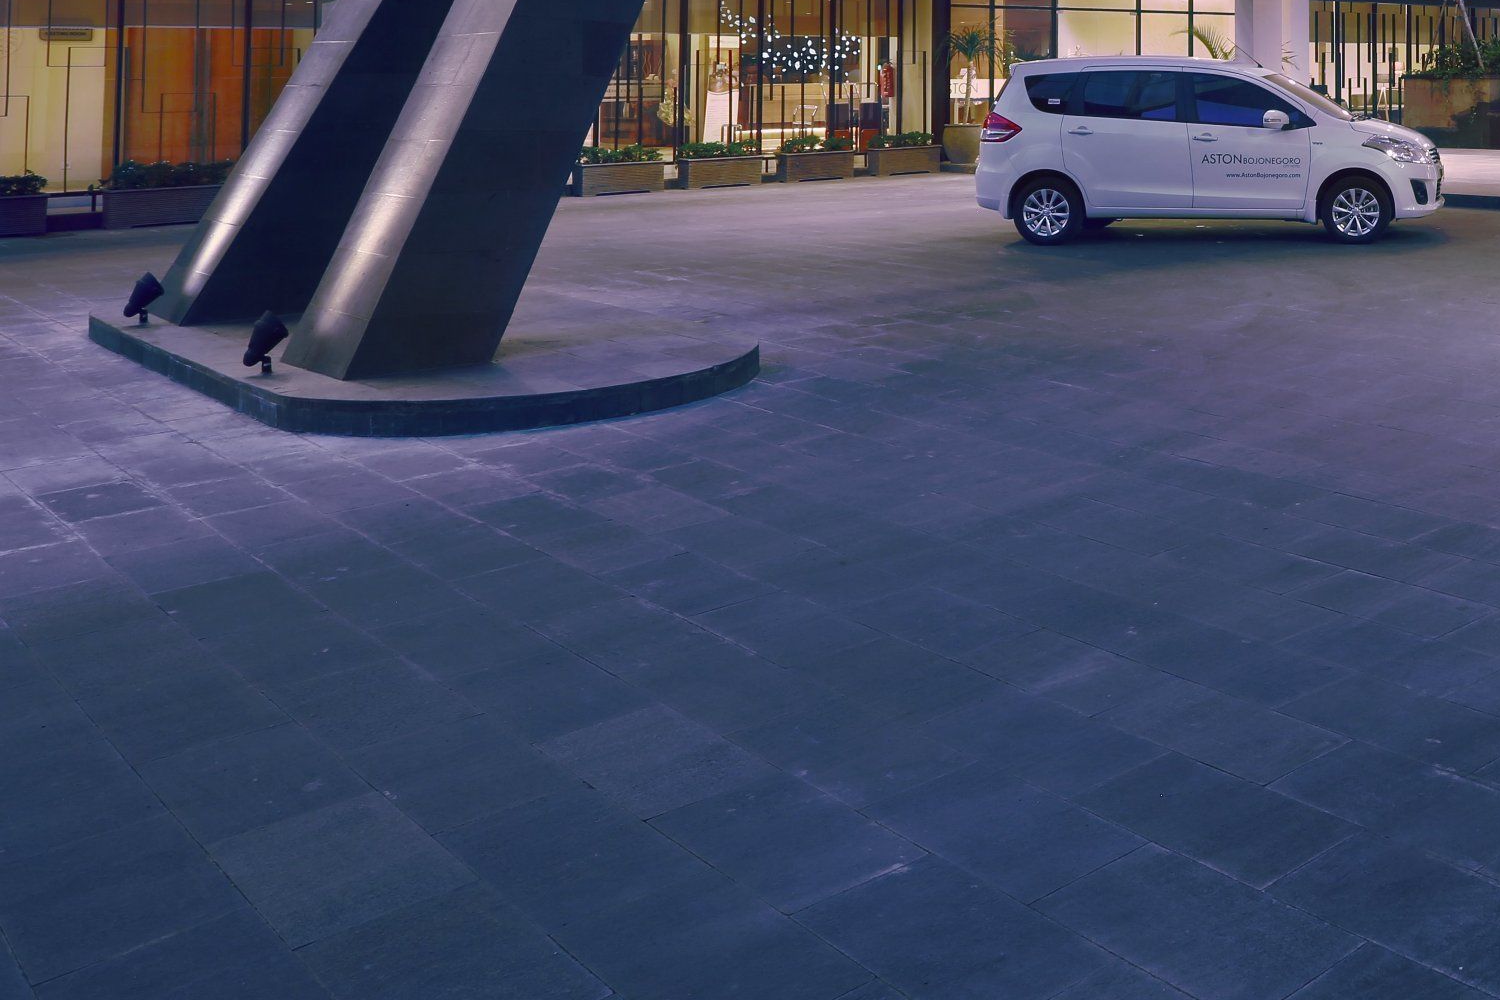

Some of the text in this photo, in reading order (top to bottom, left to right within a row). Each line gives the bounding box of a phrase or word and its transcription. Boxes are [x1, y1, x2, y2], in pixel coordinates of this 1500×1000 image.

[1201, 153, 1301, 165] ASTON BOJONEGORO
[1226, 171, 1301, 180] www.AstonBojonegoro.com
